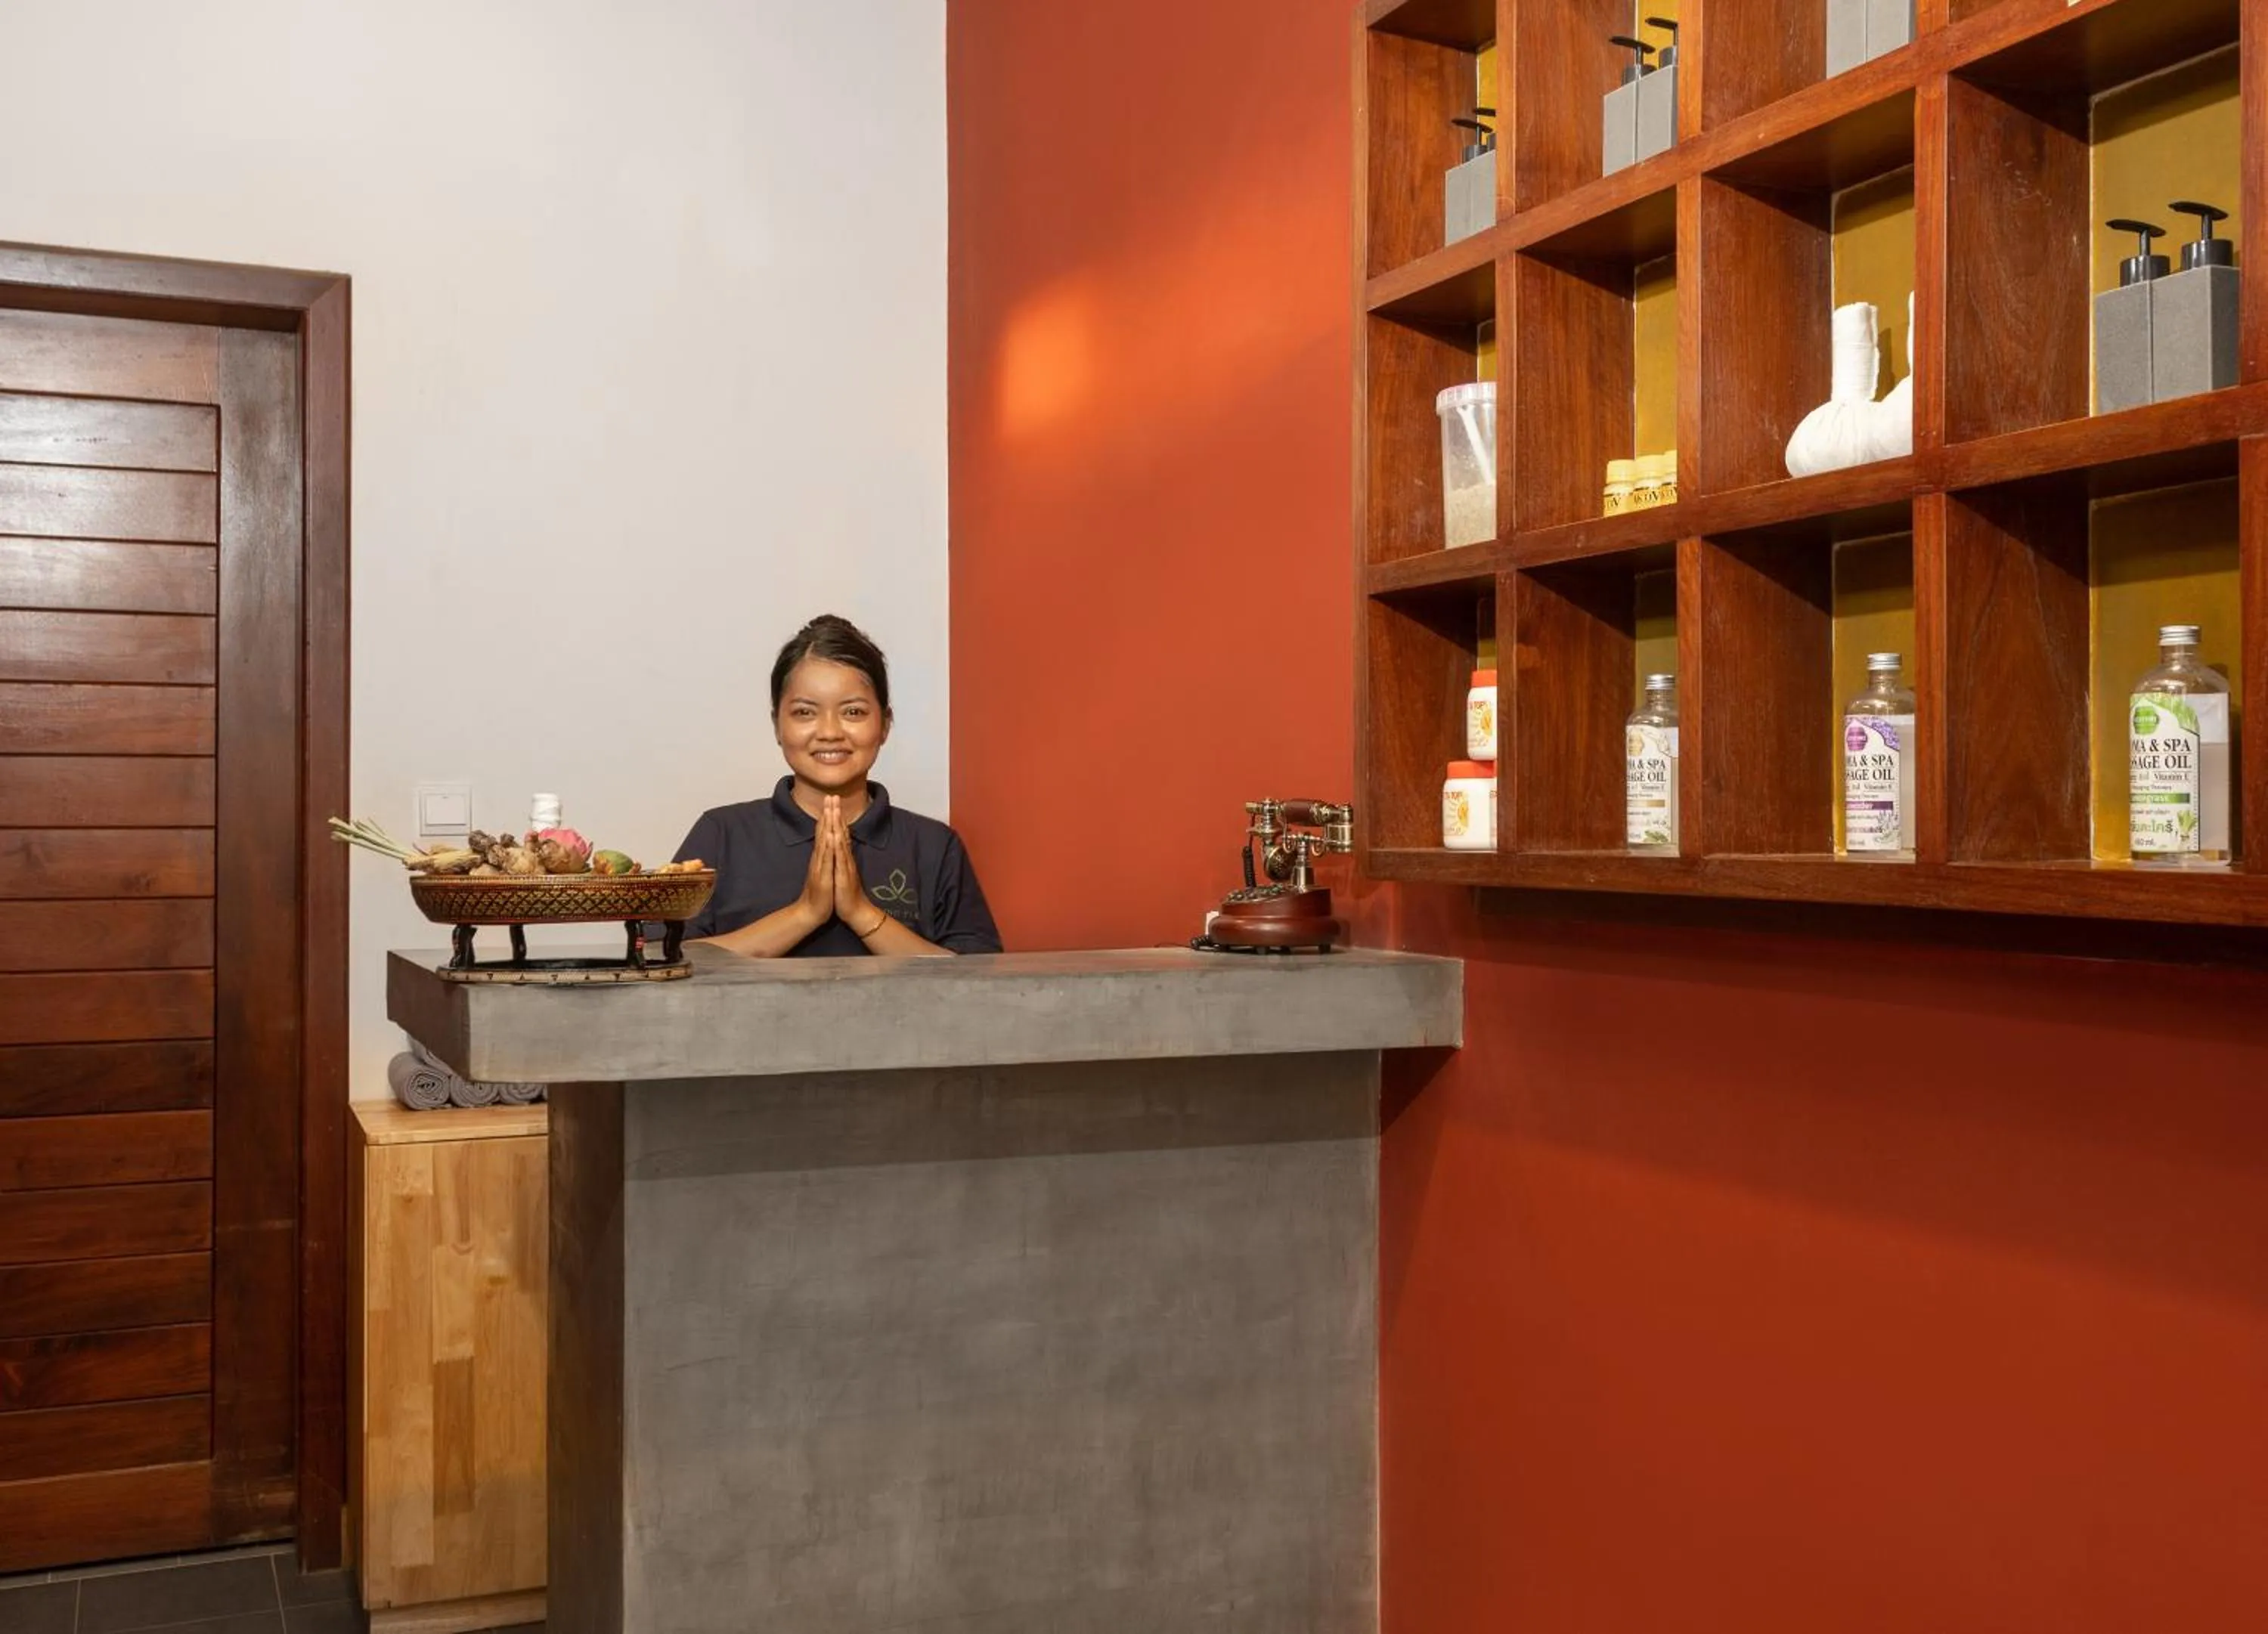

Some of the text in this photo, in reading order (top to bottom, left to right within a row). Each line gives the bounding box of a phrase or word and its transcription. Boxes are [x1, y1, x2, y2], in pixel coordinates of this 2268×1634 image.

[2149, 738, 2160, 752] &
[2163, 738, 2192, 752] SPA
[1647, 758, 1666, 770] SPA
[1860, 754, 1868, 766] &
[1871, 754, 1894, 766] SPA
[2164, 755, 2192, 769] OIL
[1647, 772, 1667, 782] OIL
[1873, 769, 1895, 781] OIL
